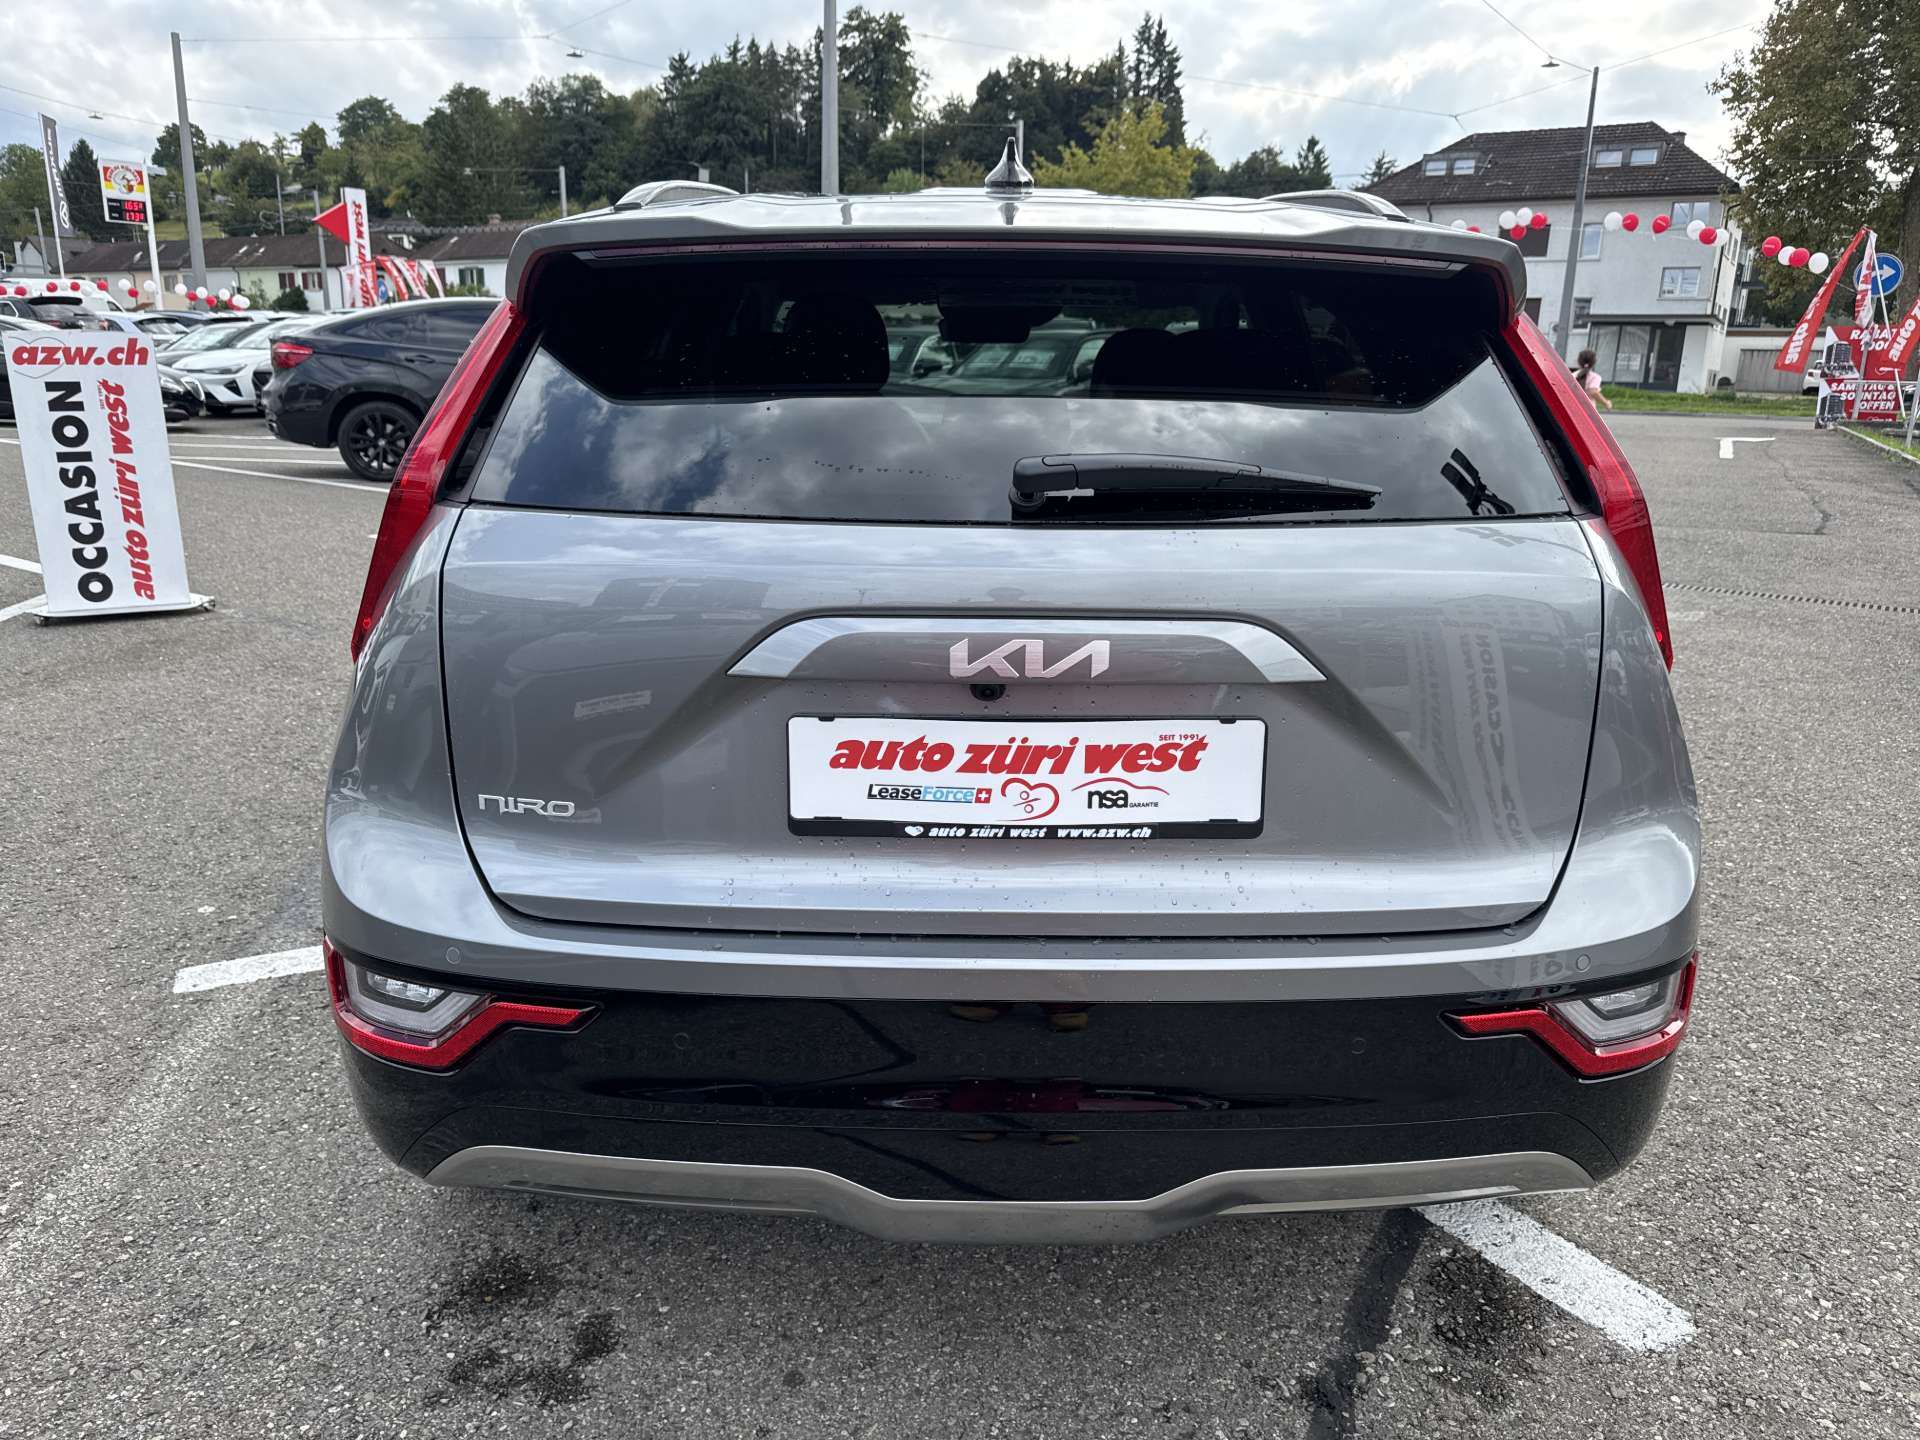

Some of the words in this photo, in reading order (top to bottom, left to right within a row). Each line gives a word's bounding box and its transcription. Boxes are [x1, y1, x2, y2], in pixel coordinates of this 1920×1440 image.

[12, 338, 149, 366] azw.ch
[1888, 318, 1916, 362] auto
[1831, 382, 1886, 391] SAMTAG
[1840, 391, 1896, 400] SONTAG
[97, 377, 134, 455] west
[1860, 400, 1895, 410] OFFEN
[44, 381, 114, 603] OCCASION
[108, 458, 145, 529] züri
[123, 529, 156, 601] auto
[949, 638, 1110, 679] KIA
[1158, 734, 1176, 742] SEIT
[1178, 733, 1200, 741] 1991
[829, 734, 954, 772] auto
[955, 736, 1080, 775] züri
[1083, 734, 1209, 774] west
[478, 794, 576, 817] NIRO
[867, 783, 975, 803] LeaseForce
[1087, 789, 1129, 809] nsa
[928, 826, 966, 838] auto
[968, 825, 1006, 838] züri
[1008, 826, 1047, 838] west
[1057, 826, 1151, 838] www.azw.ch
